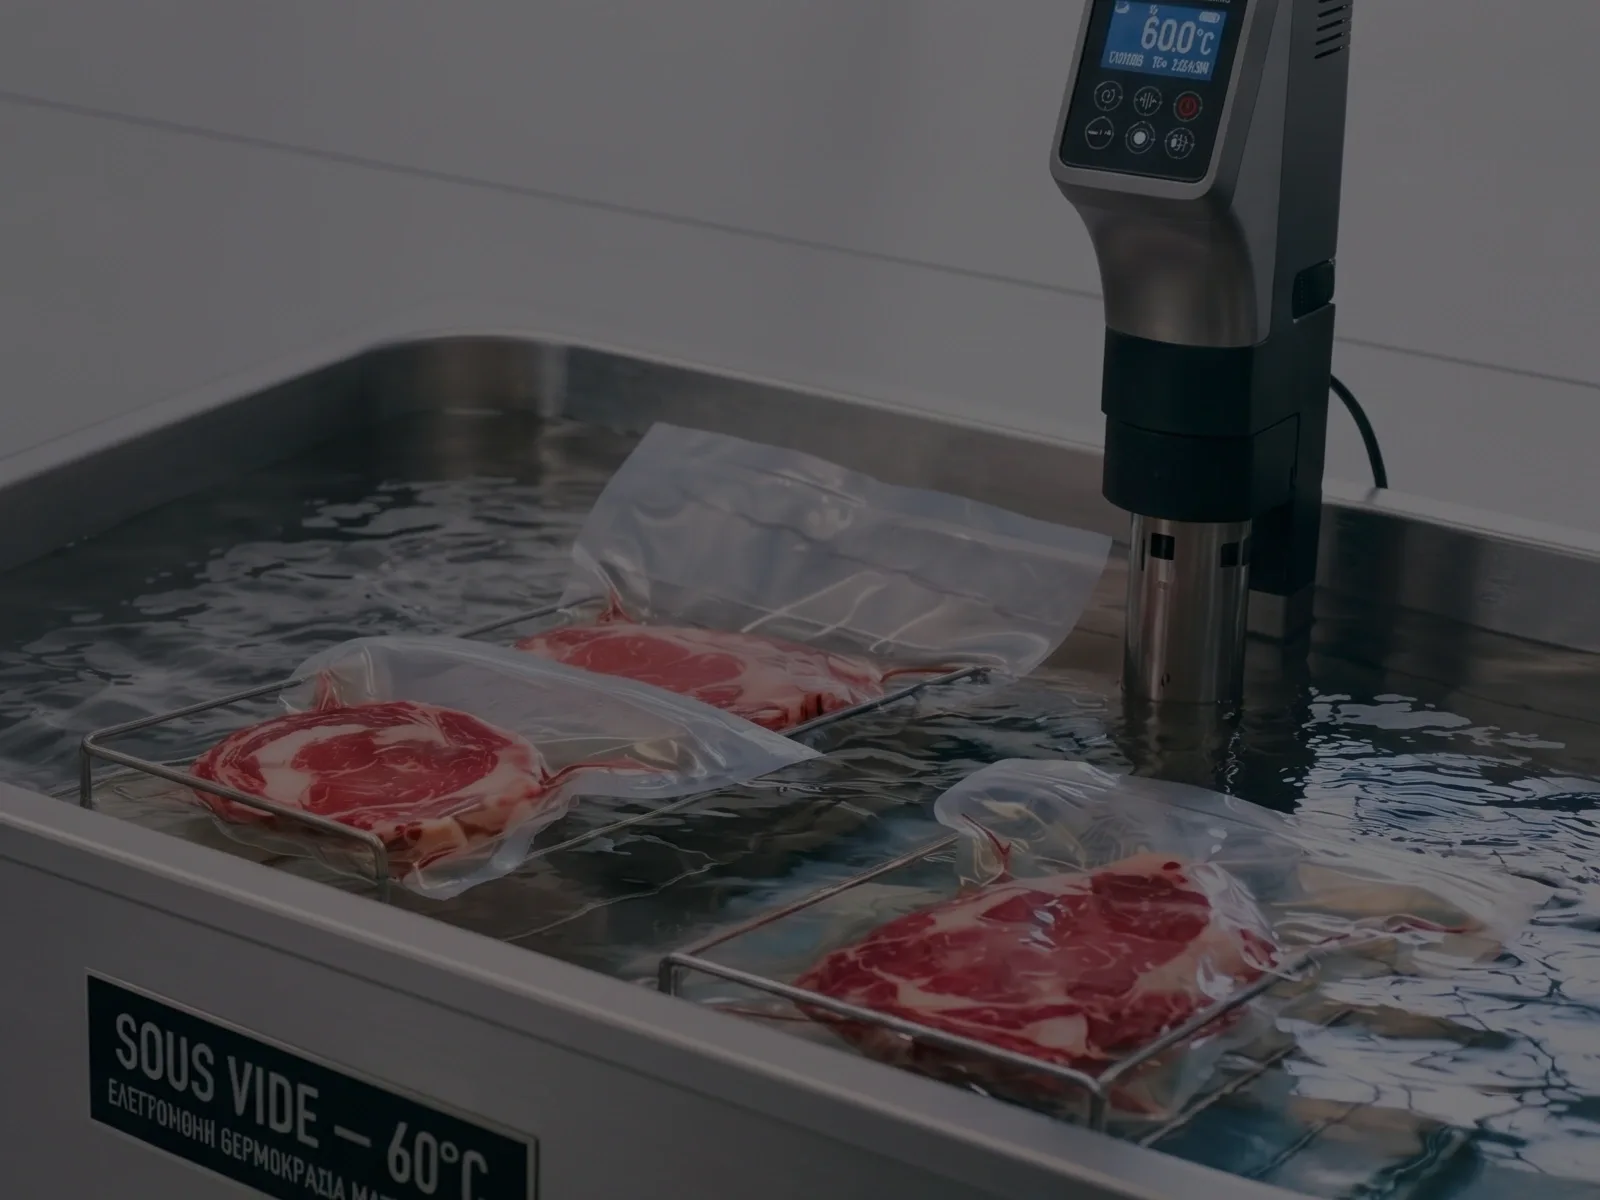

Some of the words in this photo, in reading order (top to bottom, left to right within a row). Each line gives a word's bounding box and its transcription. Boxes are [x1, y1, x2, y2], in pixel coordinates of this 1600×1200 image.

[115, 1012, 214, 1103] SOUS
[227, 1055, 319, 1149] VIDE
[387, 1121, 489, 1200] 60°C
